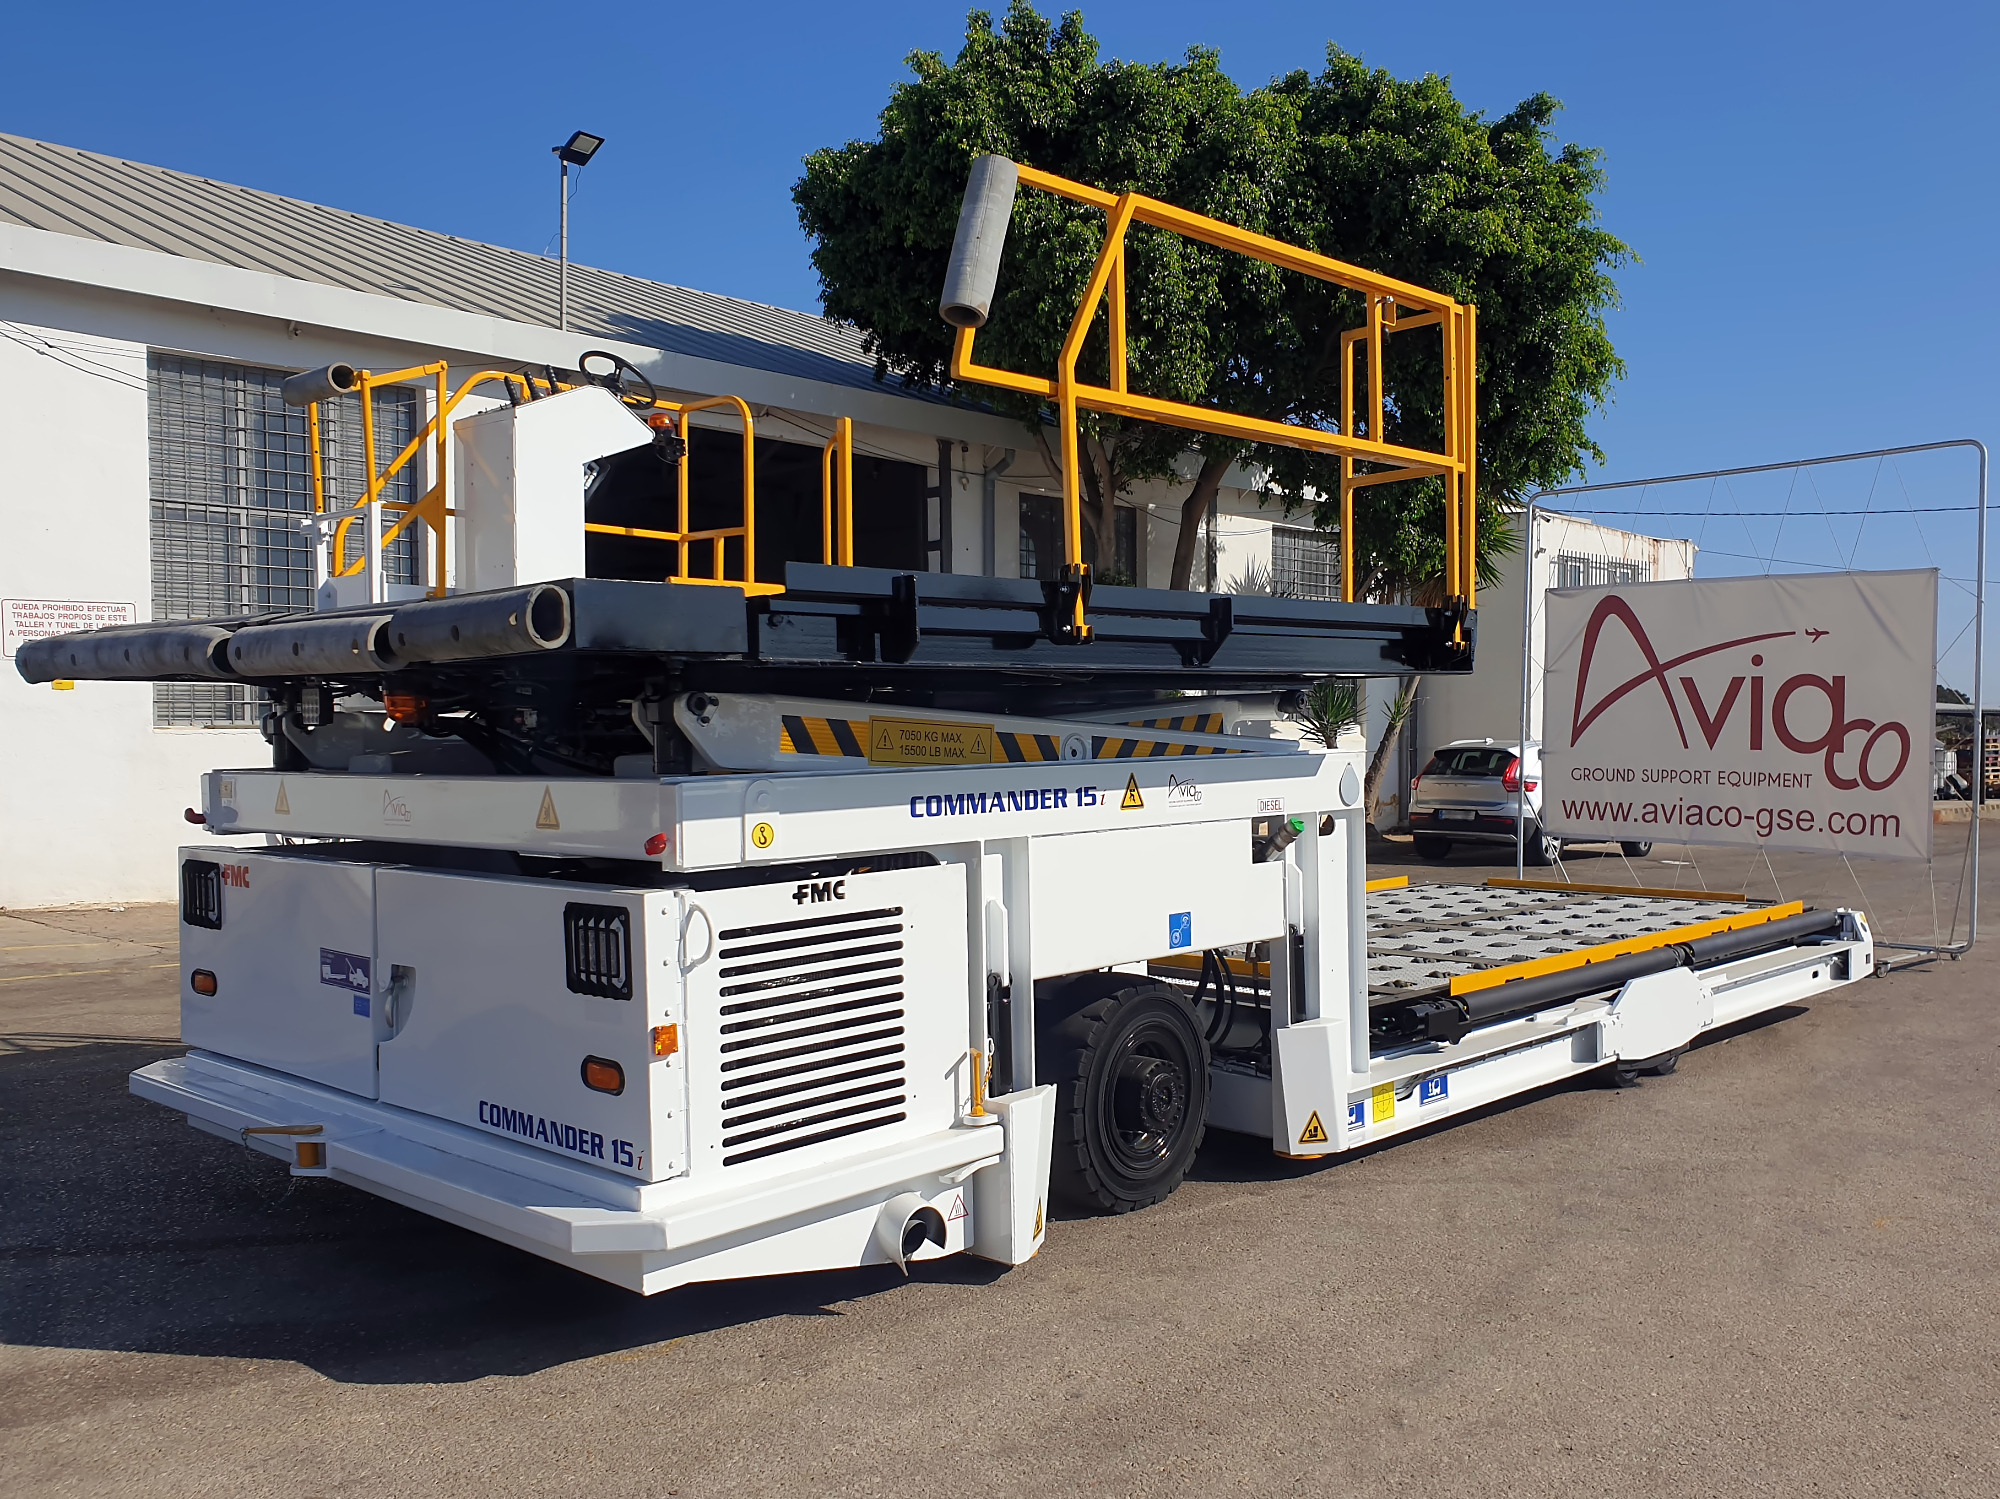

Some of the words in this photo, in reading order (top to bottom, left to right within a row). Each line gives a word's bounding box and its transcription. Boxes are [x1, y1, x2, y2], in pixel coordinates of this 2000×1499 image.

[11, 603, 39, 611] QUEDA
[42, 604, 85, 612] PROHIBIDO
[87, 605, 127, 613] EFECTUAR
[11, 612, 55, 620] TRABAJOS
[57, 613, 92, 621] PROPIOS
[107, 614, 128, 622] ESTE
[8, 629, 15, 637] A
[14, 620, 45, 628] TALLER
[55, 621, 81, 629] TUNEL
[1570, 594, 1911, 791] Aviaco
[899, 729, 922, 741] 7050
[924, 731, 939, 742] KG
[941, 732, 965, 744] MAX.
[899, 744, 927, 757] 15500
[929, 746, 941, 757] LB
[943, 746, 967, 759] MAX.
[1570, 767, 1636, 783] GROUND
[1641, 769, 1712, 786] SUPPORT
[1717, 770, 1813, 789] EQUIPMENT
[910, 788, 1068, 818] COMMANDER
[1259, 799, 1283, 812] DIESEL
[1561, 797, 1901, 838] www.aviaco-gse.com
[220, 863, 250, 889] FMC
[792, 879, 846, 906] FMC
[478, 1099, 605, 1160] COMMANDER
